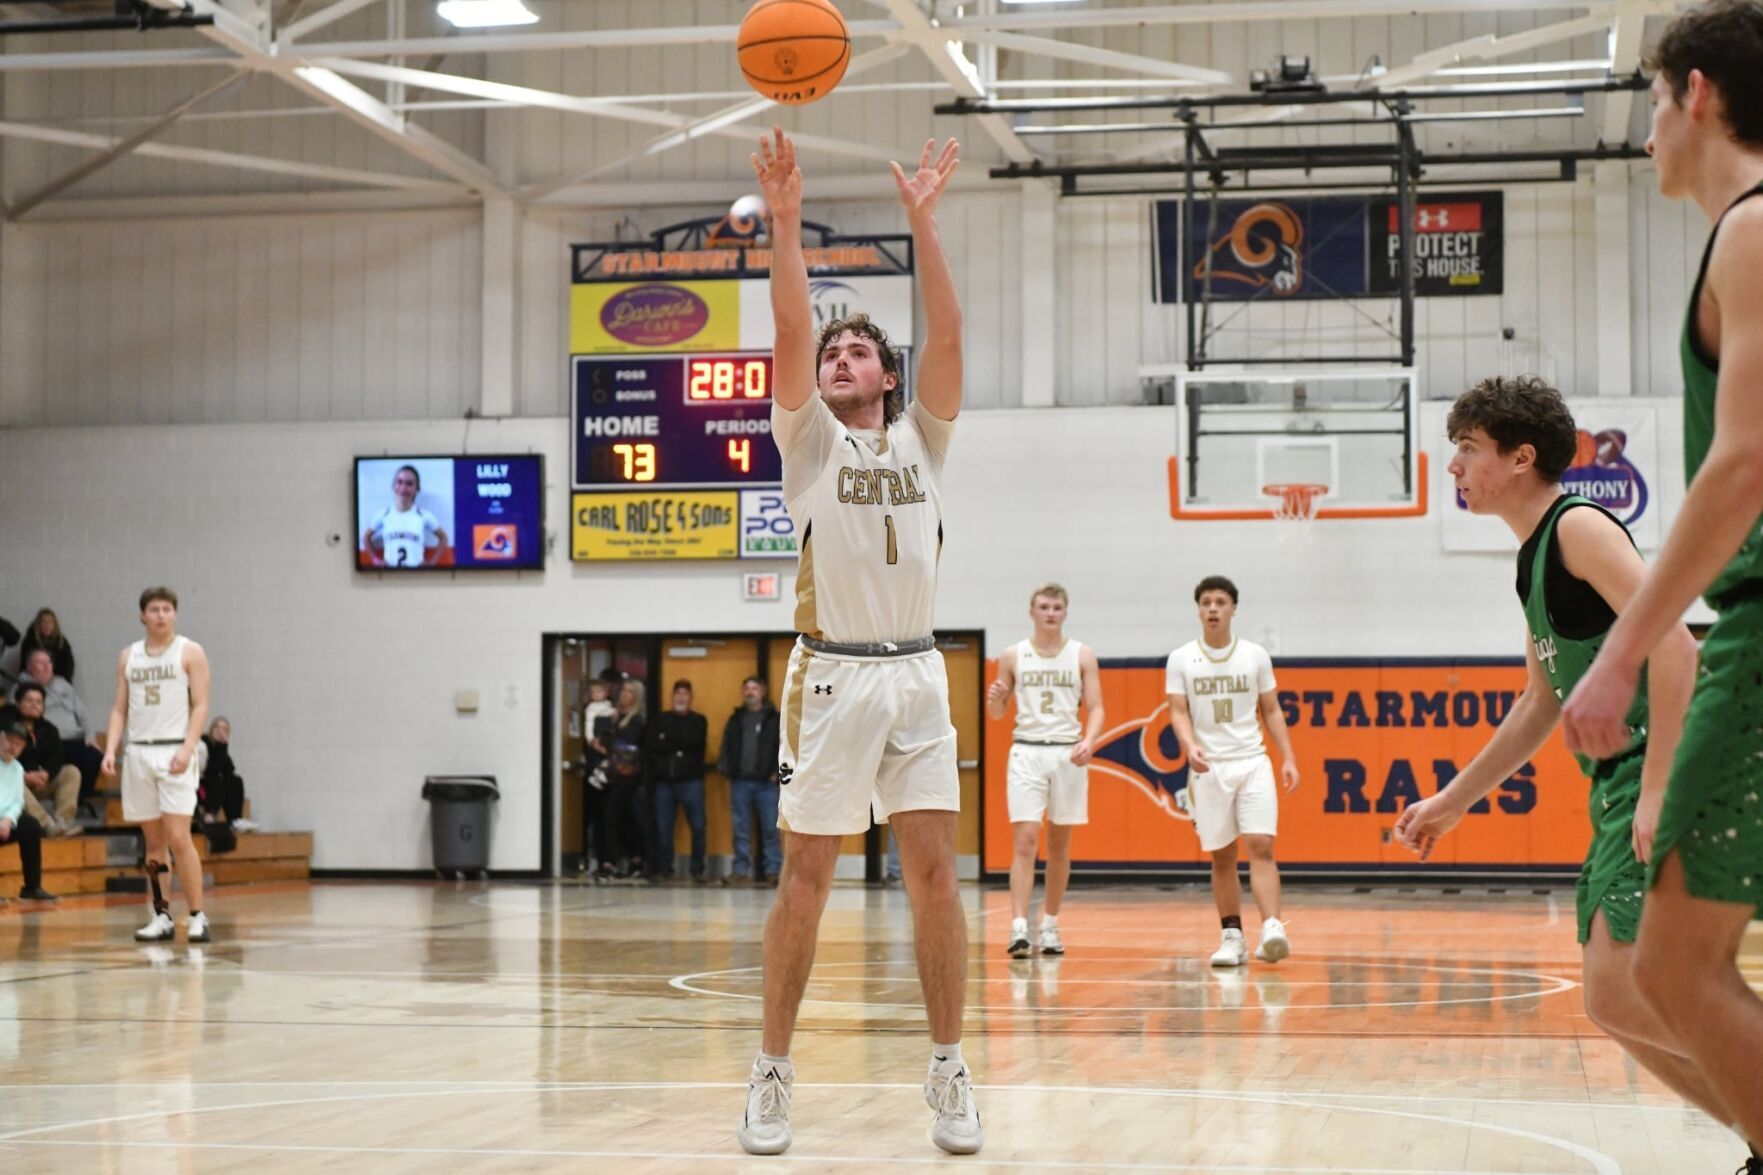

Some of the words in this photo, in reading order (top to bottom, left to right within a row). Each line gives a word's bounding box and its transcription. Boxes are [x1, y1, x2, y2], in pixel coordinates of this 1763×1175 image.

[1388, 232, 1484, 258] POTECT
[1388, 258, 1424, 279] TS
[615, 369, 647, 381] POSS
[691, 361, 766, 399] 28:0
[615, 389, 656, 401] BONUS
[584, 416, 660, 437] HOME
[705, 419, 771, 435] PERIOD
[613, 444, 656, 482] 73
[728, 439, 750, 473] 4
[476, 464, 509, 479] LILLY
[1559, 480, 1628, 499] NTHONY
[578, 505, 620, 532] CARL
[626, 498, 673, 535] ROSE
[884, 515, 898, 565] 1
[131, 664, 177, 683] CENTRAL
[1022, 670, 1074, 688] CENTRAL
[1193, 674, 1250, 695] CENTRAL
[144, 685, 161, 706] 15
[1040, 691, 1054, 714] 2
[1212, 698, 1233, 723] 10
[1277, 690, 1524, 728] STARMOU
